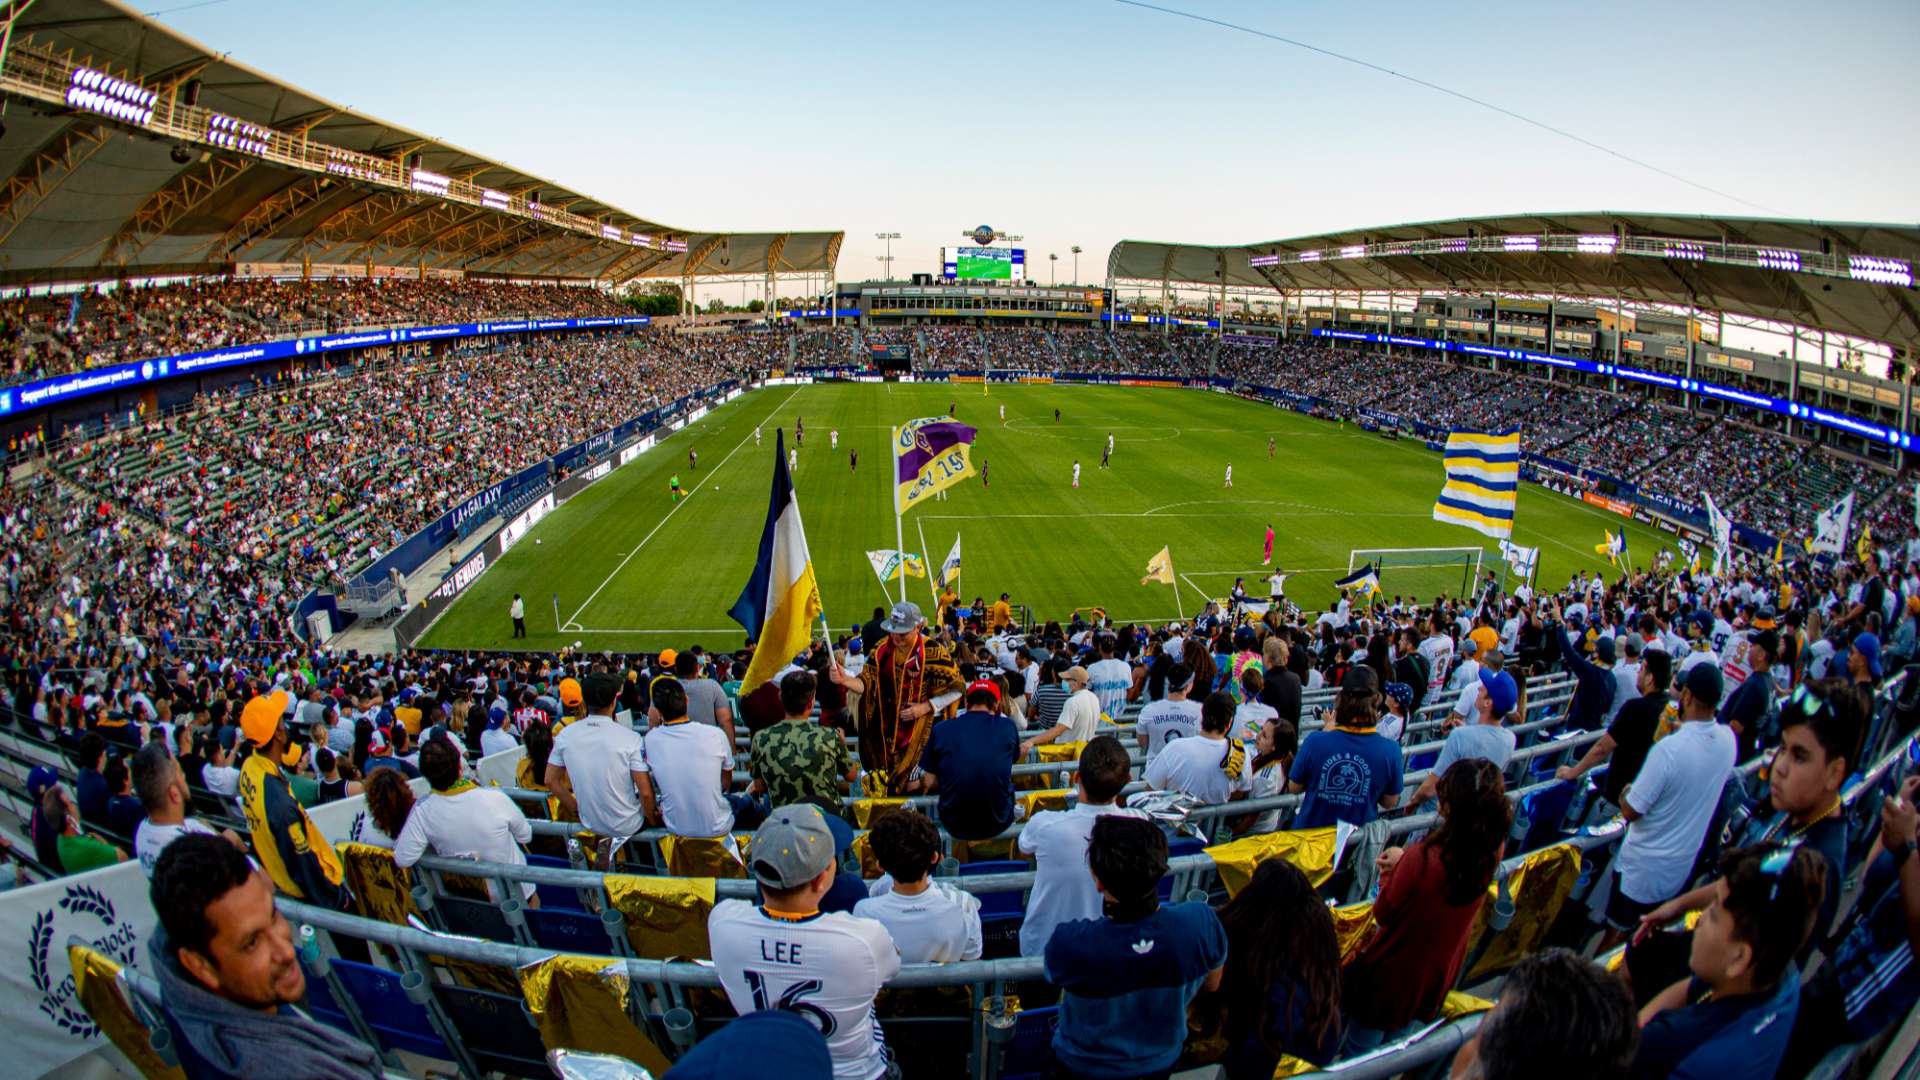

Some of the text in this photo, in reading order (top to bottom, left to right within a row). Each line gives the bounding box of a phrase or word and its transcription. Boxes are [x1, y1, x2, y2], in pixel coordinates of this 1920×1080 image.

[452, 485, 503, 530] LA GALAXY
[761, 939, 802, 965] LEE
[743, 969, 837, 1039] 16
